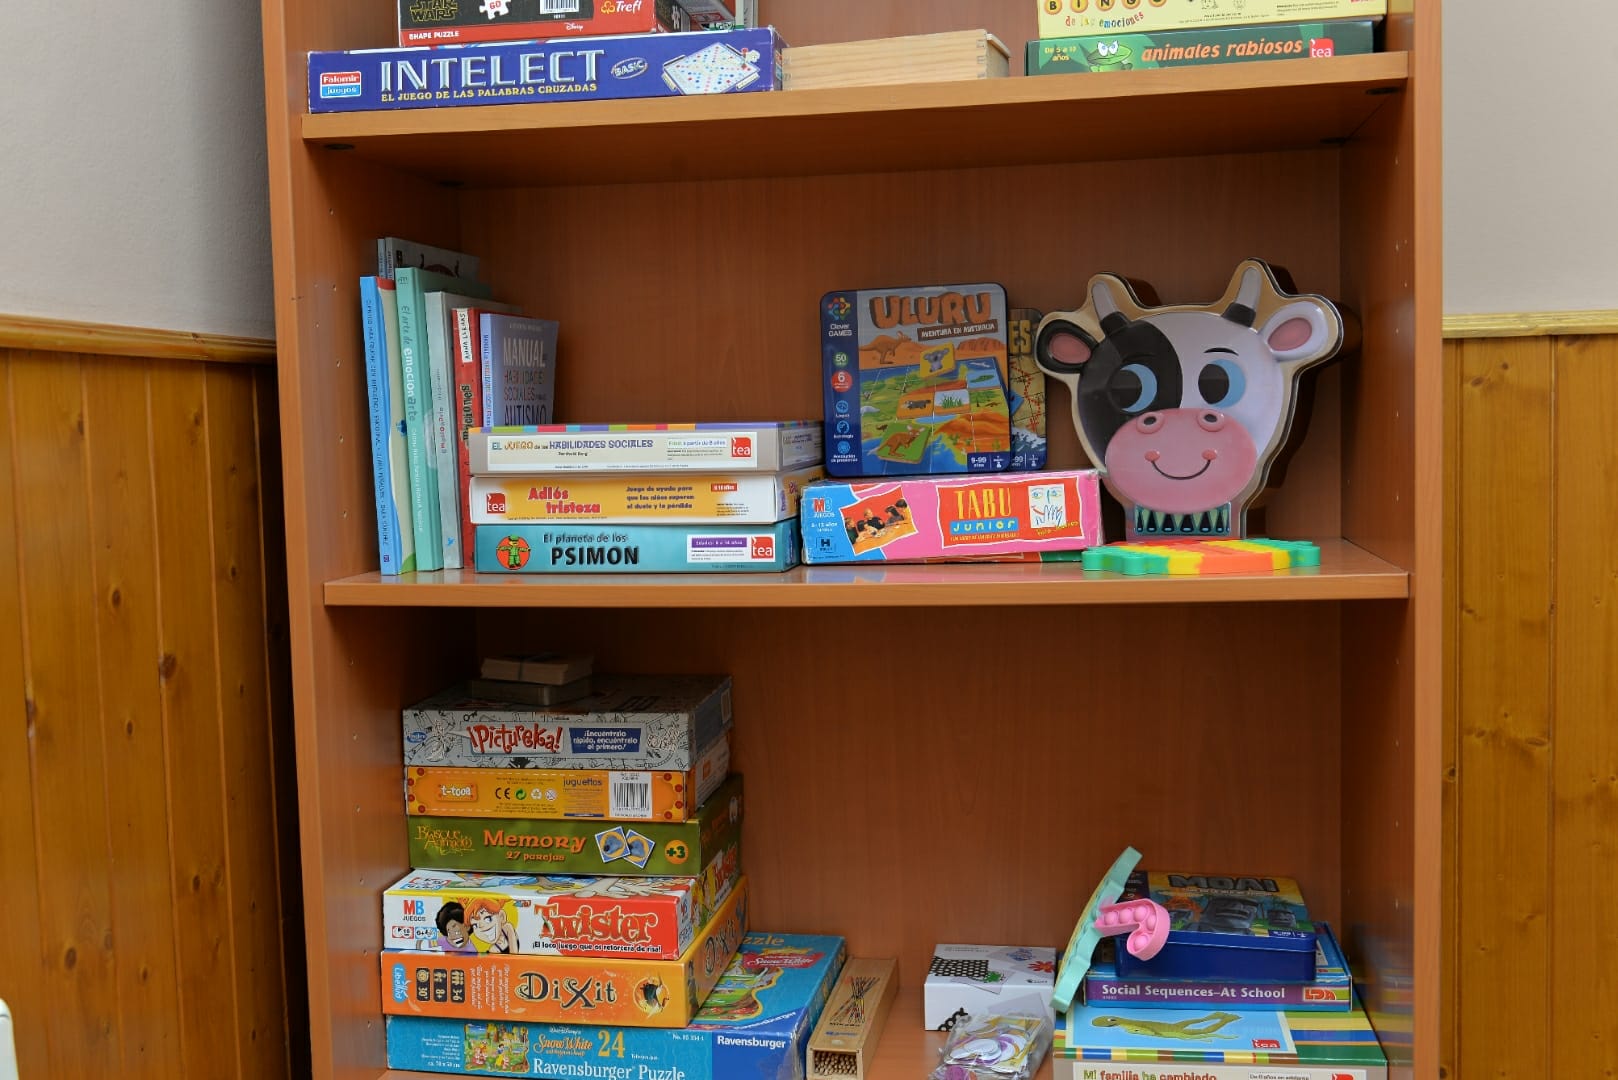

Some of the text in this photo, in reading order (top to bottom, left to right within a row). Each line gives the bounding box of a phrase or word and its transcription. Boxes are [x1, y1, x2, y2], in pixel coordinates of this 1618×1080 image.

[615, 0, 642, 13] Trefl
[411, 9, 457, 22] WARS
[1099, 11, 1145, 29] emociones
[409, 30, 460, 40] SHAPE PUZZLE
[1141, 38, 1303, 63] animales rabiosos
[1311, 47, 1332, 58] tea
[380, 49, 605, 92] INTELECT
[614, 59, 646, 77] BASIC
[323, 73, 360, 84] Falomir
[327, 86, 357, 95] juegos
[381, 83, 598, 102] EL JUEGO DE LAS PALABRAS CRUZADAS
[401, 305, 410, 315] El
[868, 291, 992, 330] ULURU
[402, 316, 411, 333] arte
[921, 322, 995, 339] AVENTURA EN AUSTRALIA
[403, 335, 413, 345] de
[503, 337, 547, 368] MANUAL
[835, 354, 847, 362] 50
[837, 371, 846, 383] 6
[492, 441, 502, 450] EL
[504, 440, 534, 450] JUEGO
[549, 440, 606, 450] HABILIDADES
[608, 439, 654, 449] SOCIALES
[732, 446, 751, 457] tea
[650, 493, 668, 501] niños
[668, 494, 695, 502] superen
[954, 487, 1012, 520] TABU
[487, 501, 505, 512] tea
[546, 501, 601, 514] tristeza
[667, 502, 693, 510] pérdida
[543, 533, 627, 545] El planeta de los
[551, 546, 640, 566] PSIMON
[752, 545, 773, 557] tea
[466, 723, 563, 754] ¡Pictureka!
[583, 729, 627, 737] ¡Encuéntralo
[572, 736, 638, 744] rápido, encuéntralo
[596, 743, 627, 751] primero!
[563, 777, 603, 787] juguettos
[506, 851, 566, 862] 27 parejas
[666, 845, 686, 859] +3
[1168, 874, 1281, 893] MOAI
[403, 899, 425, 915] MB
[534, 903, 659, 944] Twister
[532, 941, 541, 949] ¡El
[542, 941, 557, 949] loco
[557, 941, 578, 951] juego
[579, 943, 593, 951] que
[603, 944, 635, 952] retorcerá
[636, 944, 646, 952] de
[647, 945, 661, 953] risa!
[435, 988, 446, 999] 8+
[452, 988, 463, 1001] 3-6
[1101, 984, 1140, 996] Social
[1240, 986, 1285, 999] School
[1304, 987, 1337, 1000] LDA
[533, 1034, 564, 1053] Snow
[563, 1037, 593, 1051] White
[597, 1029, 626, 1058] 24
[717, 1035, 787, 1051] Ravensburger
[1255, 1039, 1279, 1049] tea
[533, 1058, 686, 1080] Ravensburger Puzzle
[1083, 1069, 1217, 1080] Mi familia ha cambiado
